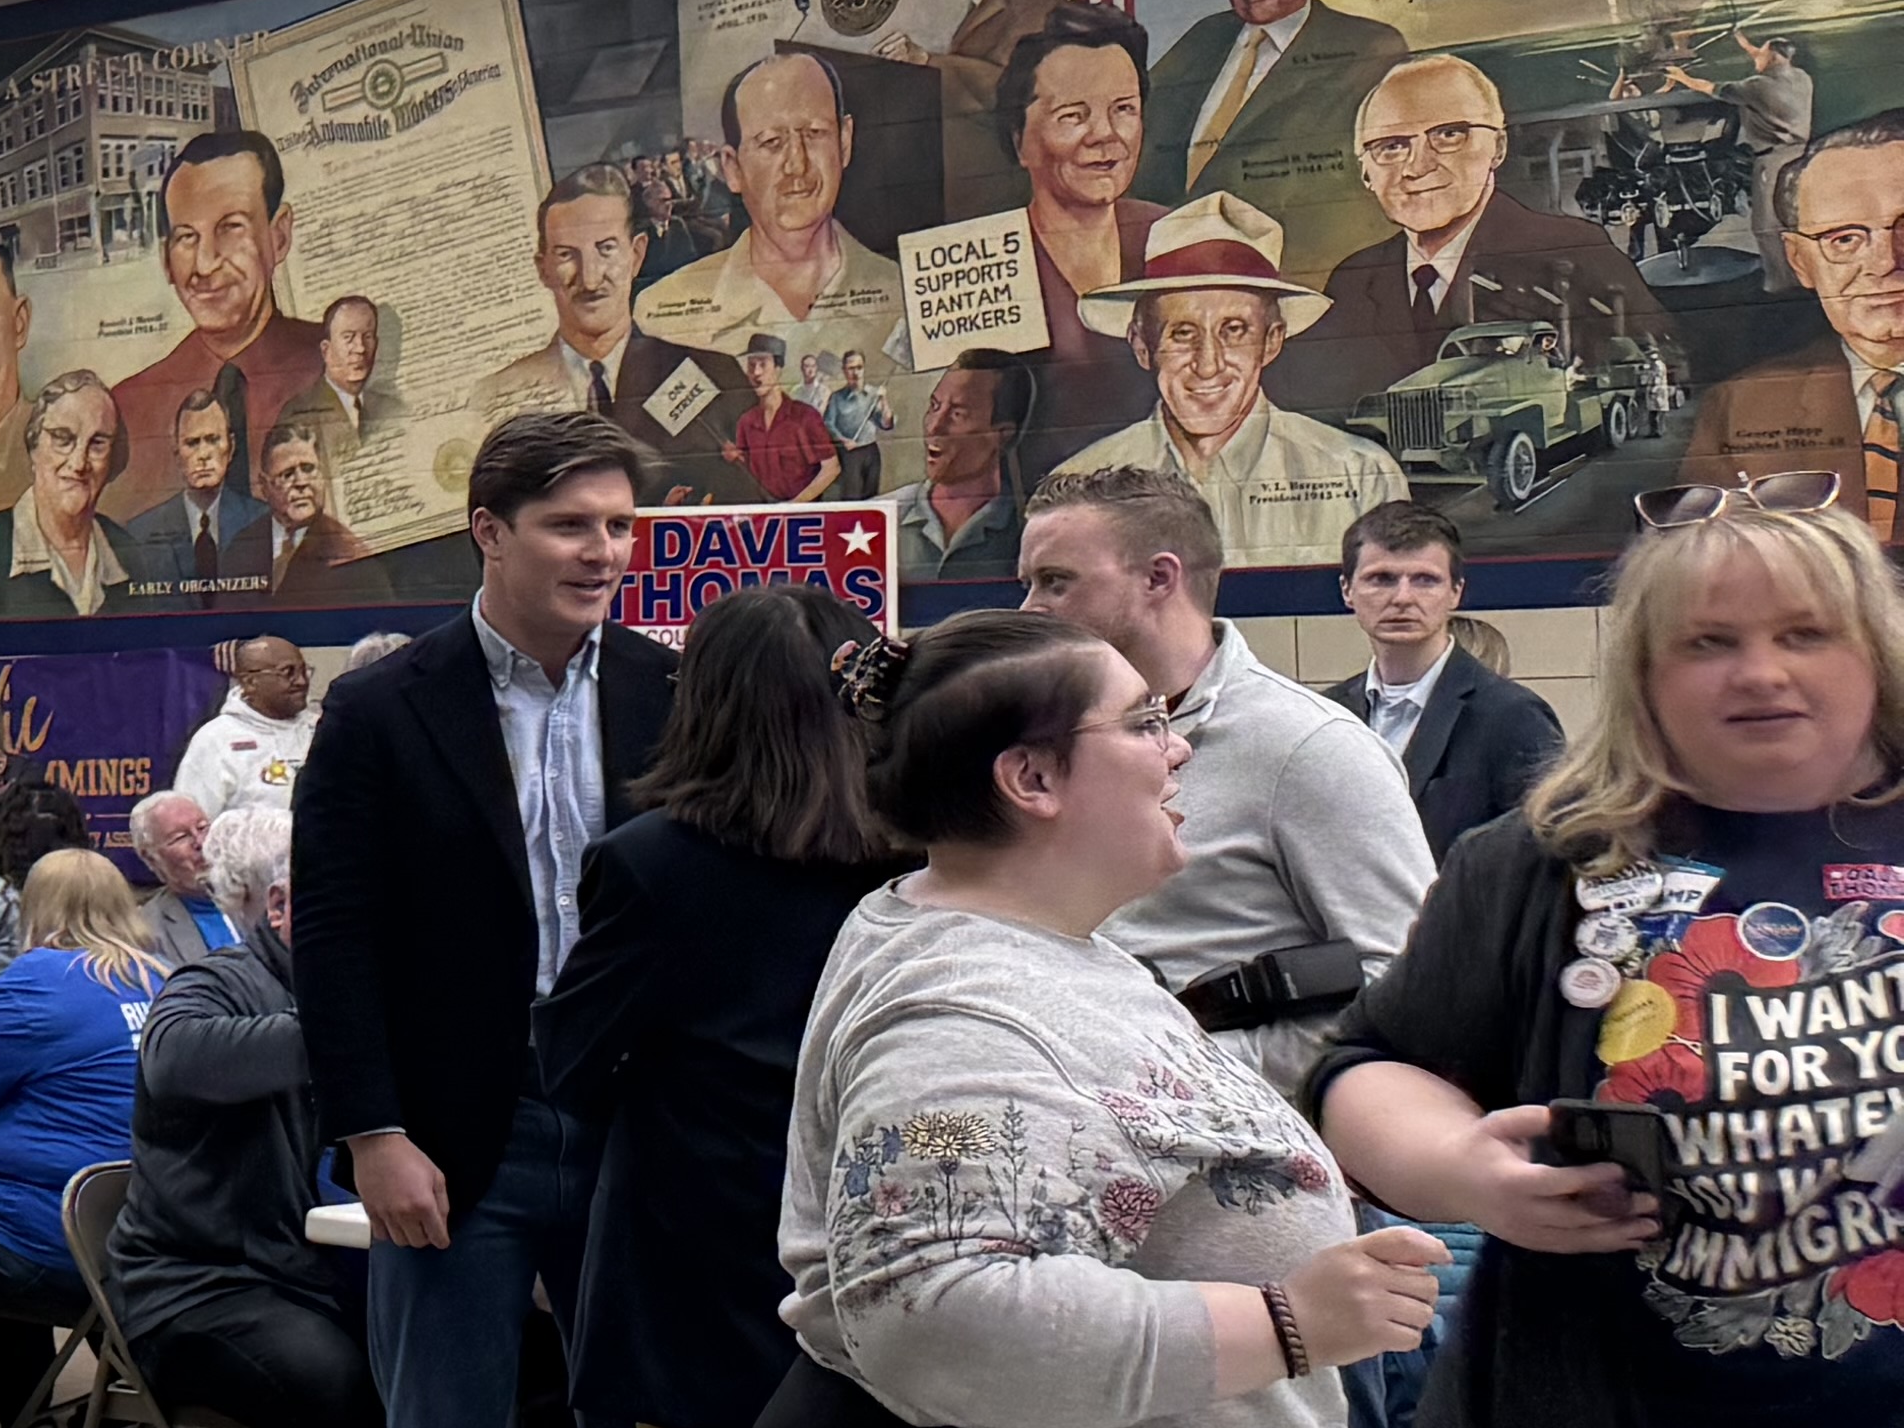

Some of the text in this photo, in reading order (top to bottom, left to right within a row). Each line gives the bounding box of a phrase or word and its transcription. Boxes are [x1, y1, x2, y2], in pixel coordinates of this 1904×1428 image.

[5, 77, 21, 101] A
[30, 52, 142, 94] STREET
[152, 29, 271, 73] CORNER
[915, 231, 1021, 272] LOCAL 5
[915, 259, 1019, 295] SUPPORTS
[920, 283, 1012, 319] BANTAM
[921, 305, 1021, 341] WORKERS
[668, 379, 686, 401] ON
[669, 382, 705, 421] STRIKE
[652, 515, 827, 570] DAVE
[129, 575, 269, 596] EARLY ORGANIZERS
[1710, 993, 1730, 1045] I
[1717, 1044, 1832, 1102] FOR
